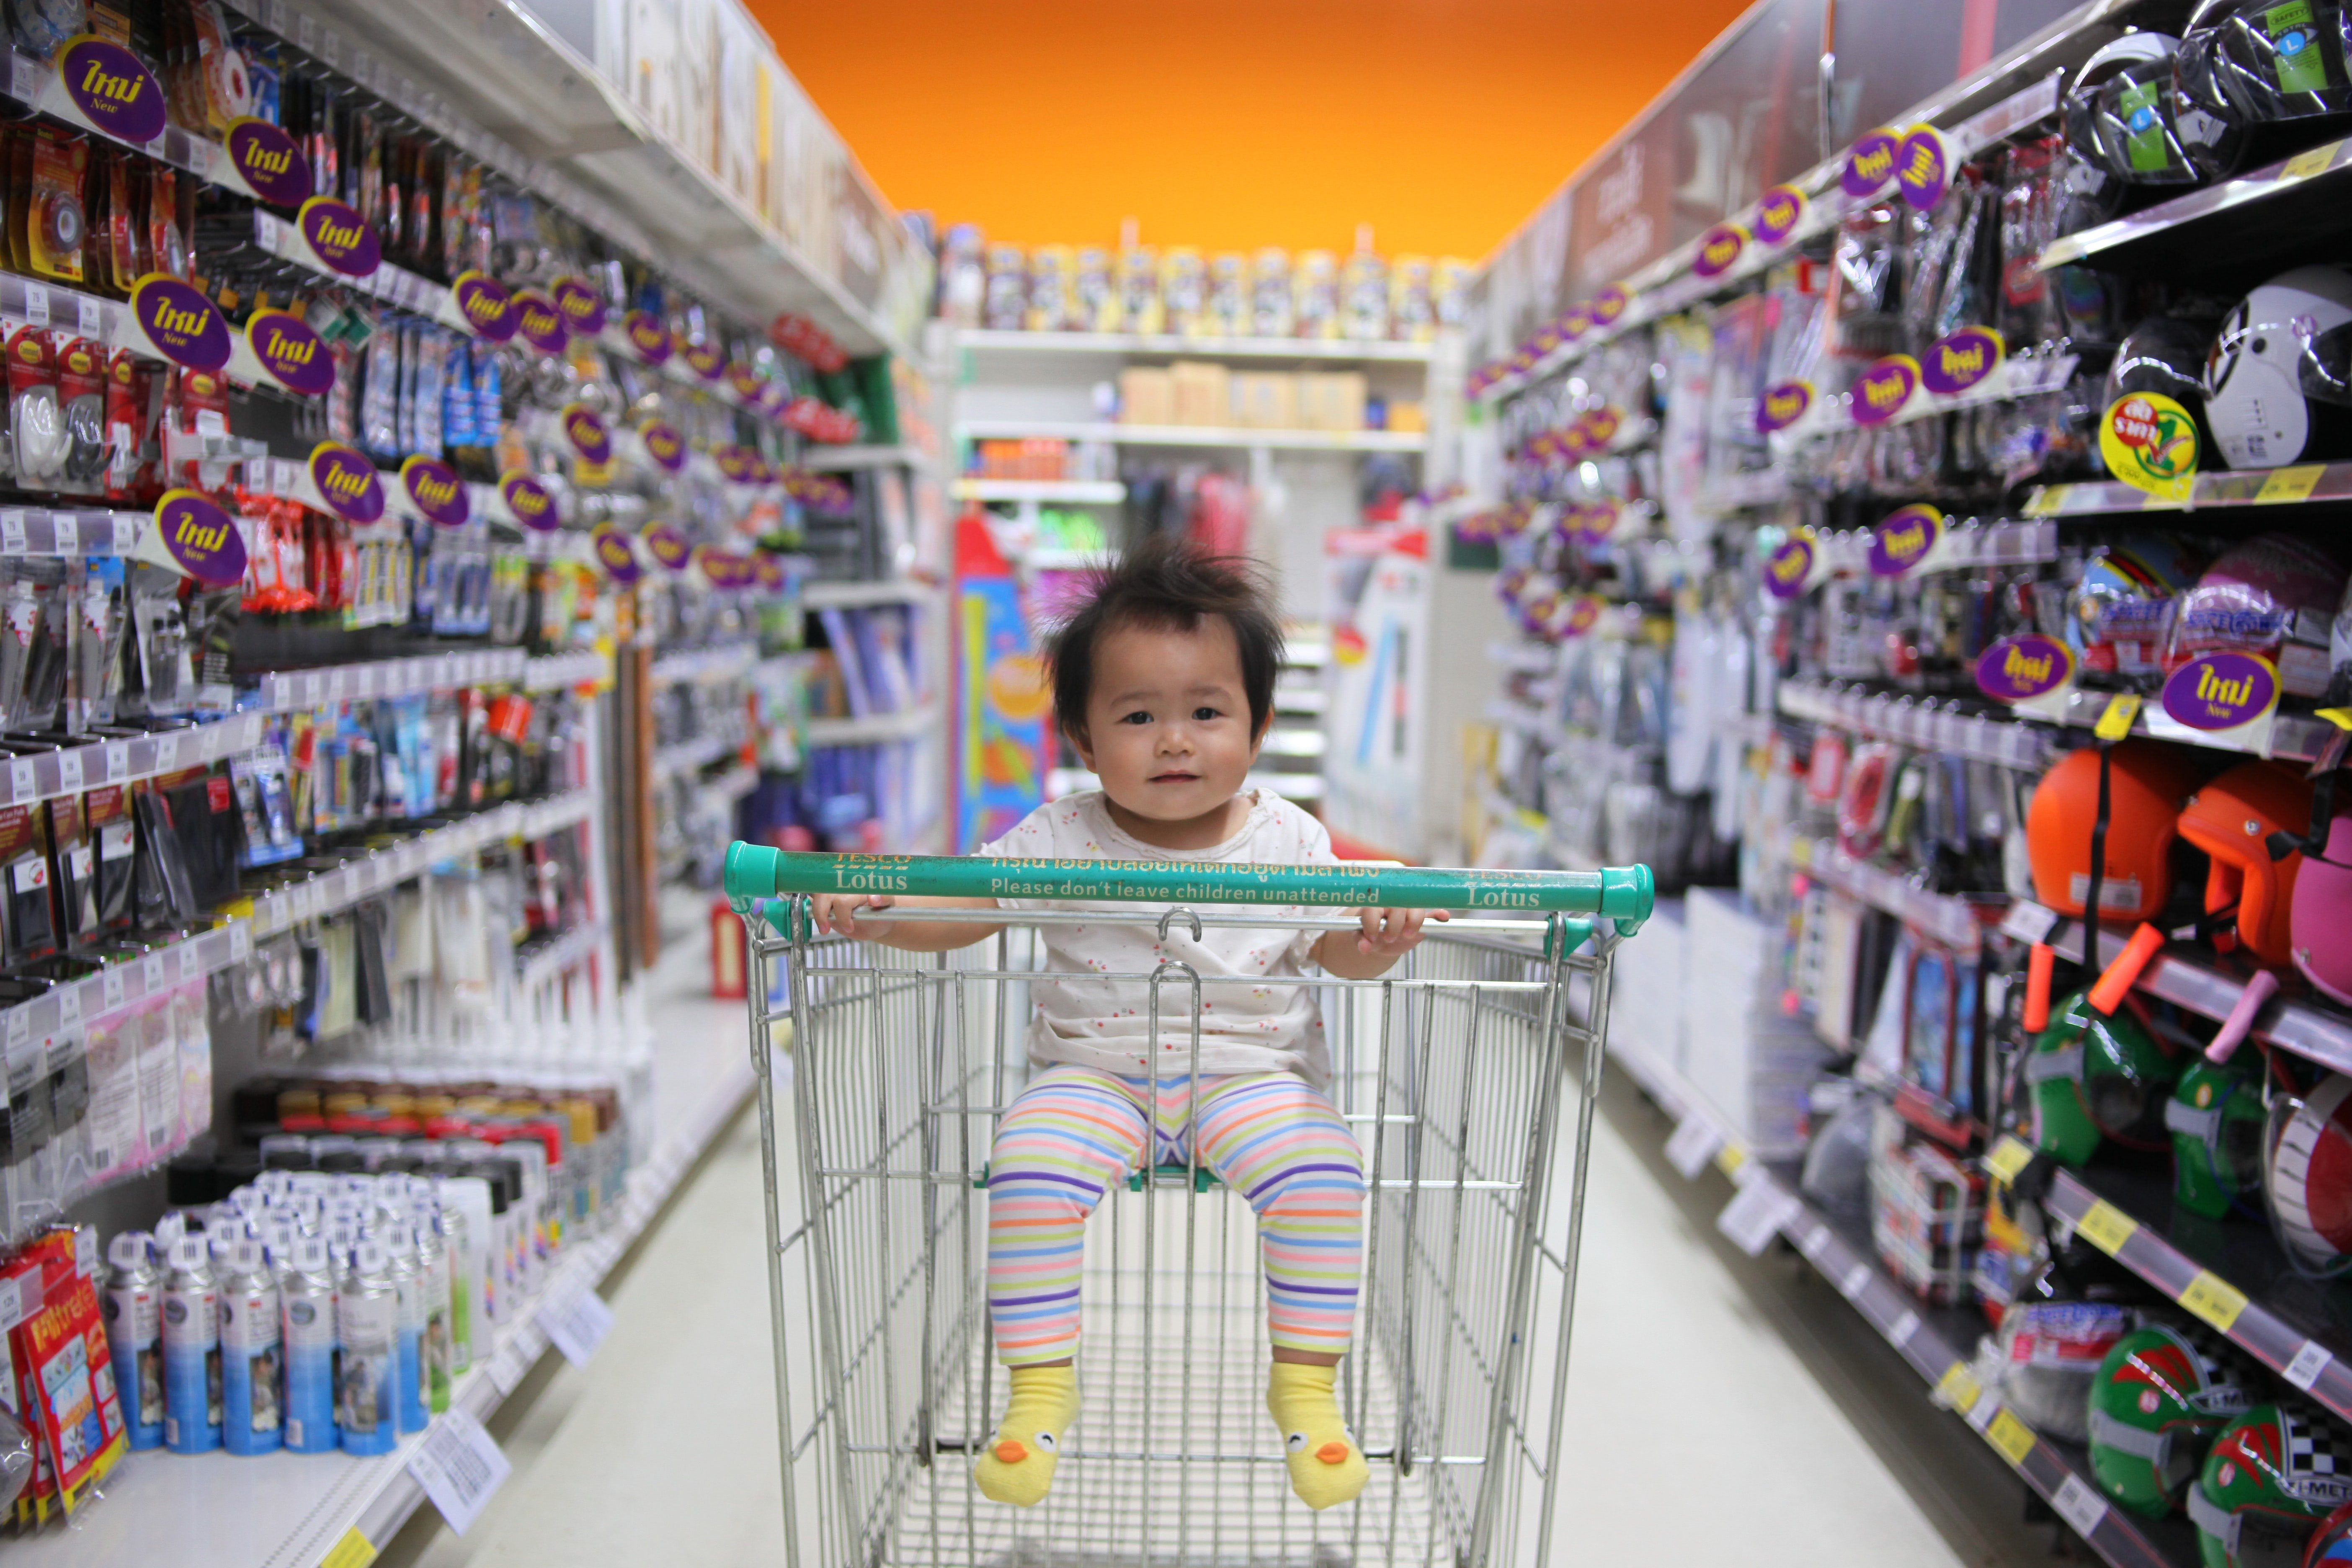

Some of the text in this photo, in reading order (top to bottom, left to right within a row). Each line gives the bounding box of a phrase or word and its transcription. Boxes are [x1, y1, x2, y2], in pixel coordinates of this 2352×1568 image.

[82, 60, 144, 102] ใหม่
[90, 99, 117, 113] New
[245, 137, 292, 174] ใหม่
[316, 216, 364, 250] ใหม่
[153, 297, 209, 336] ใหม่
[162, 332, 187, 347] New
[266, 328, 317, 364] ใหม่
[324, 460, 372, 498] ใหม่
[175, 512, 230, 552] ใหม่
[2197, 663, 2254, 707] ใหม่
[836, 870, 907, 890] Lotus
[992, 878, 1380, 903] Please don't leave children unattended
[1467, 887, 1540, 907] Lotus
